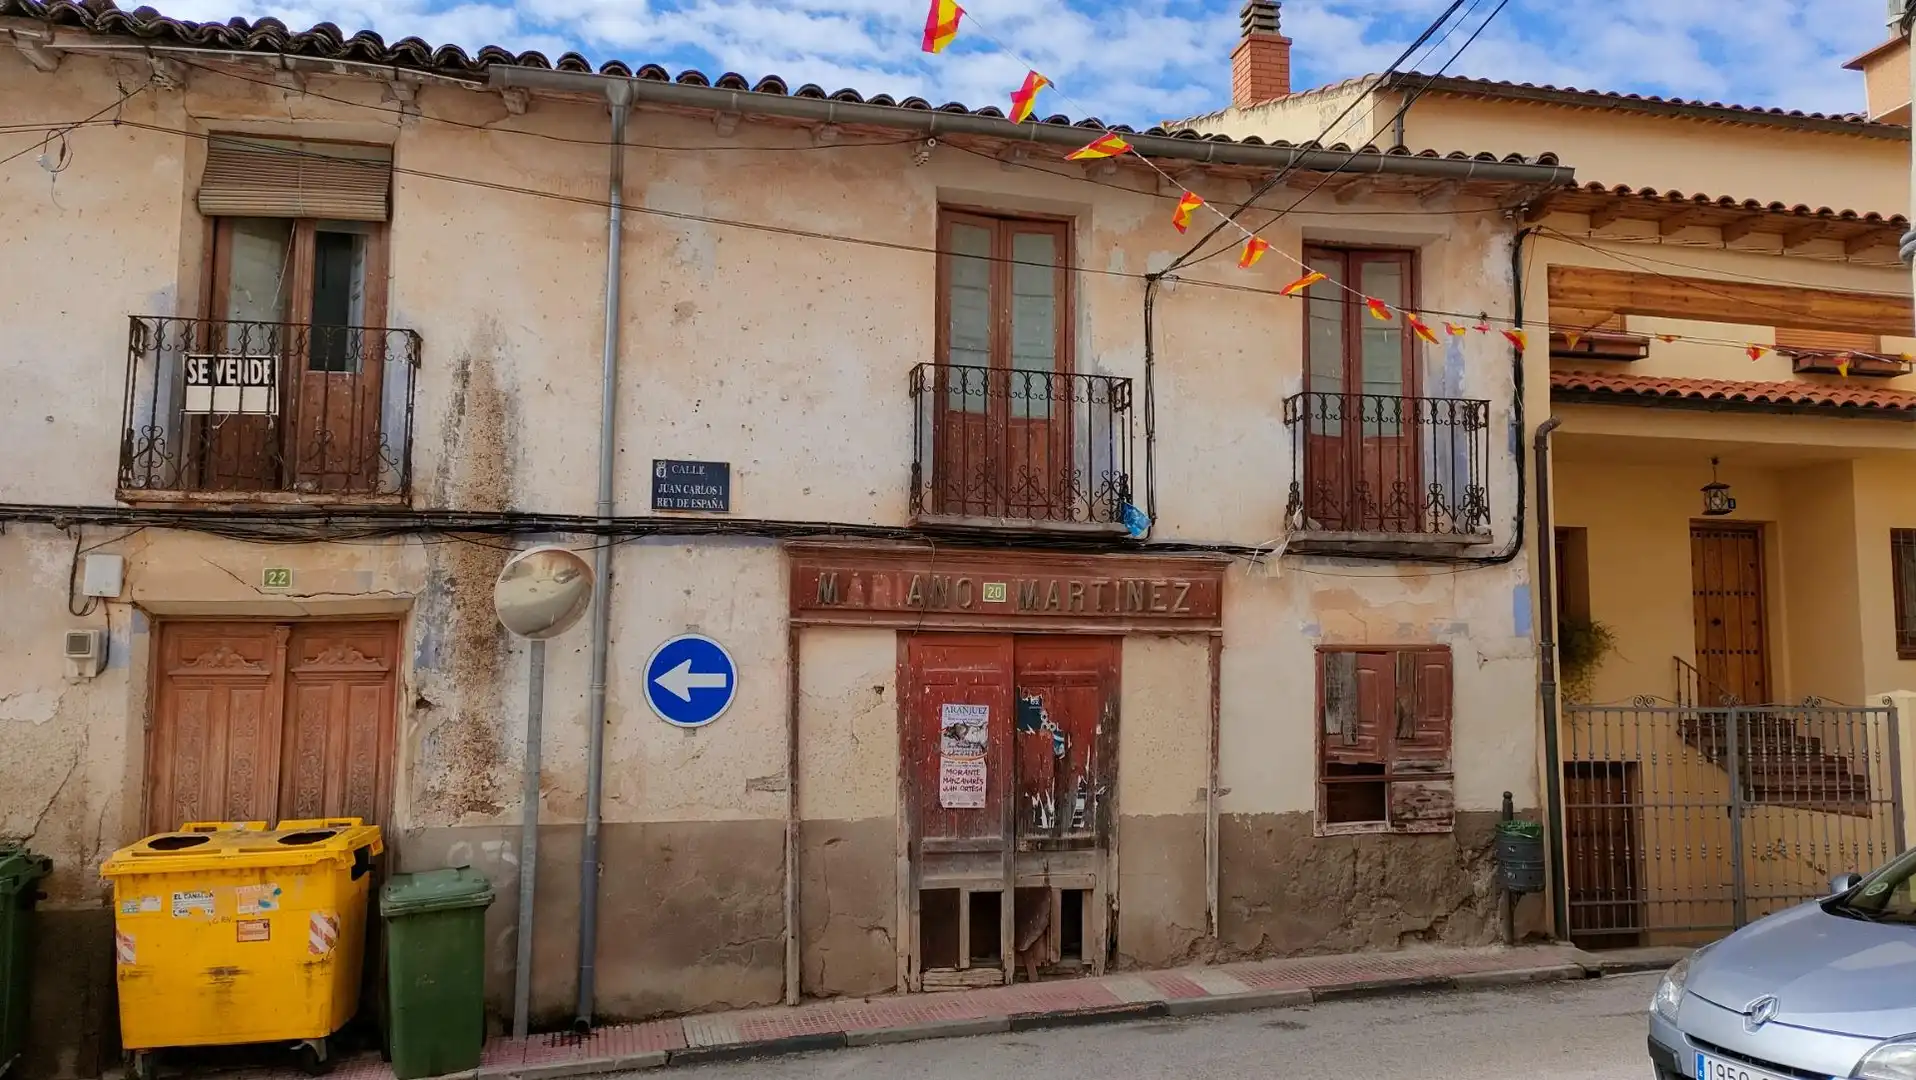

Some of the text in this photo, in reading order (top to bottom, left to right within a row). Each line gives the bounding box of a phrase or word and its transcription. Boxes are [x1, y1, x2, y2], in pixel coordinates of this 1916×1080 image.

[187, 358, 274, 385] SE VENDE
[671, 464, 706, 475] CALLE
[658, 483, 682, 494] JUAN
[683, 484, 717, 496] CARLOS
[657, 497, 724, 509] REY DE ESPAÑA
[268, 571, 287, 585] 22
[987, 586, 1002, 599] 20
[1017, 578, 1192, 613] MARTINEZ
[944, 705, 988, 716] ARANJUEZ
[945, 768, 981, 776] MORANTE
